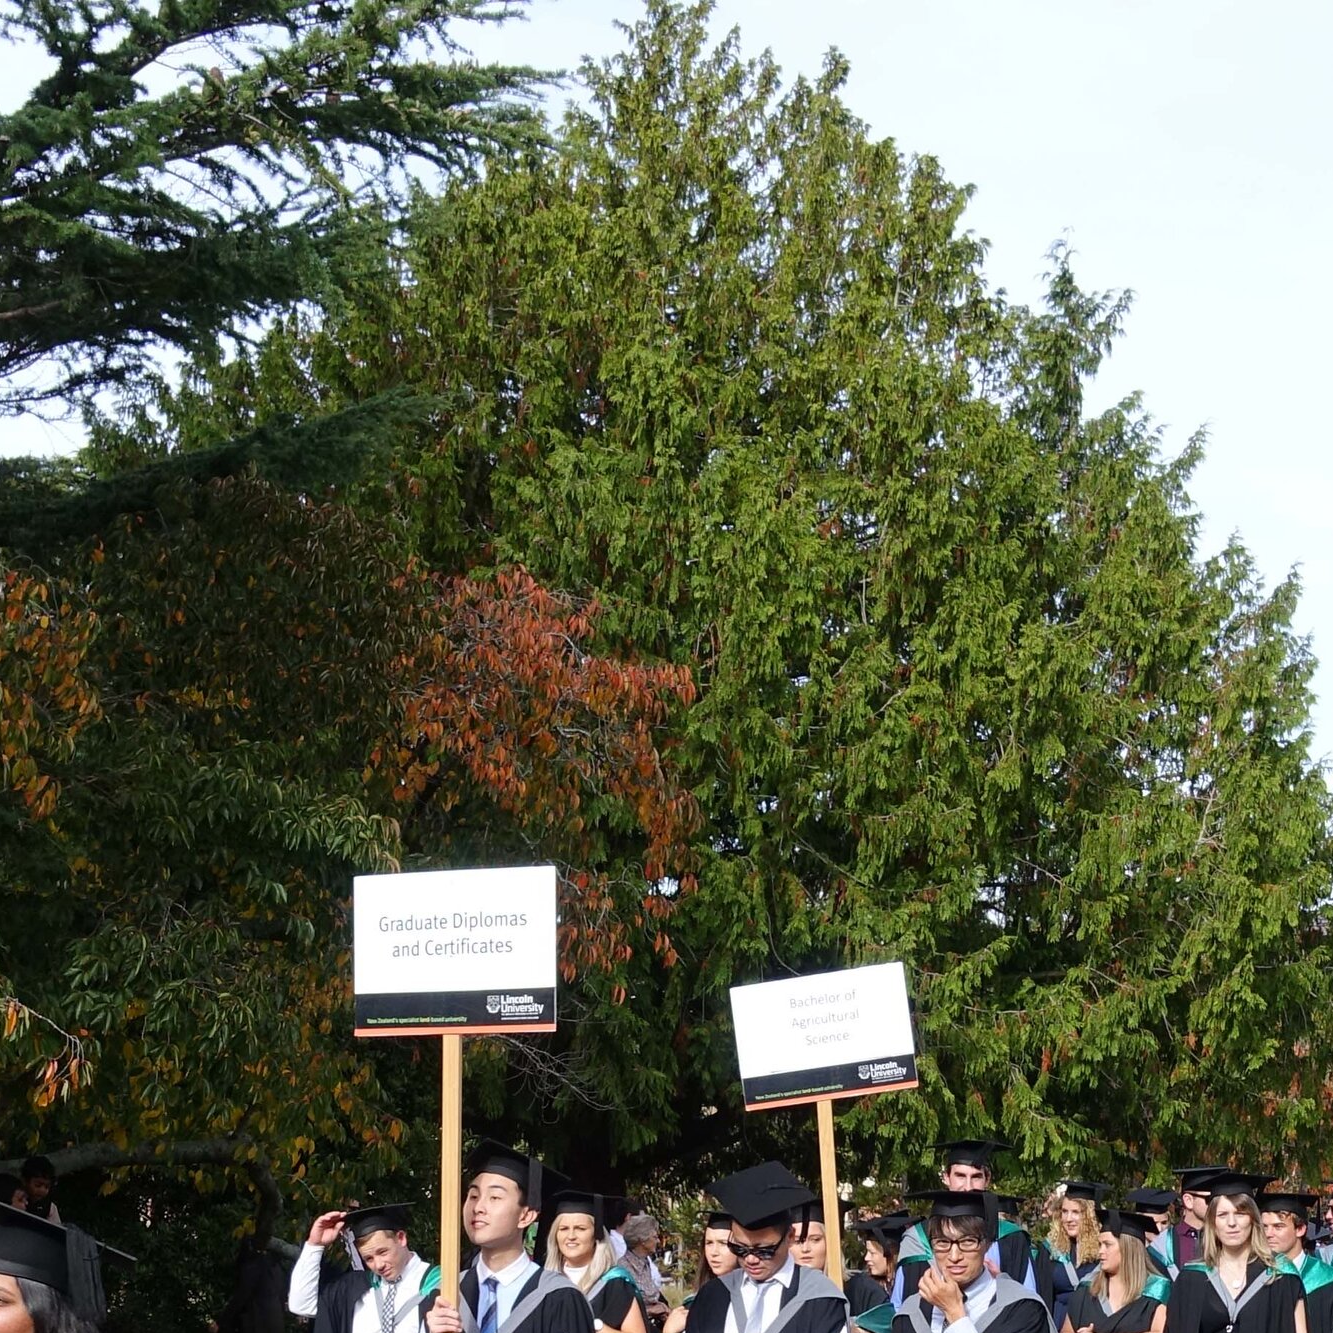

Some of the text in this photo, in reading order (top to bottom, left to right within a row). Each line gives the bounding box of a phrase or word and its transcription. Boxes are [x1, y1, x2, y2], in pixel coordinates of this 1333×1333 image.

[378, 911, 528, 932] Graduate Diplomas
[392, 937, 514, 958] and Certificates
[500, 994, 534, 1004] Lincoln
[789, 988, 857, 1009] Bachelor of
[500, 1002, 545, 1014] University
[791, 1007, 860, 1030] Agricultural
[805, 1032, 850, 1046] Science
[869, 1061, 898, 1072] Lincoln
[870, 1066, 907, 1078] University
